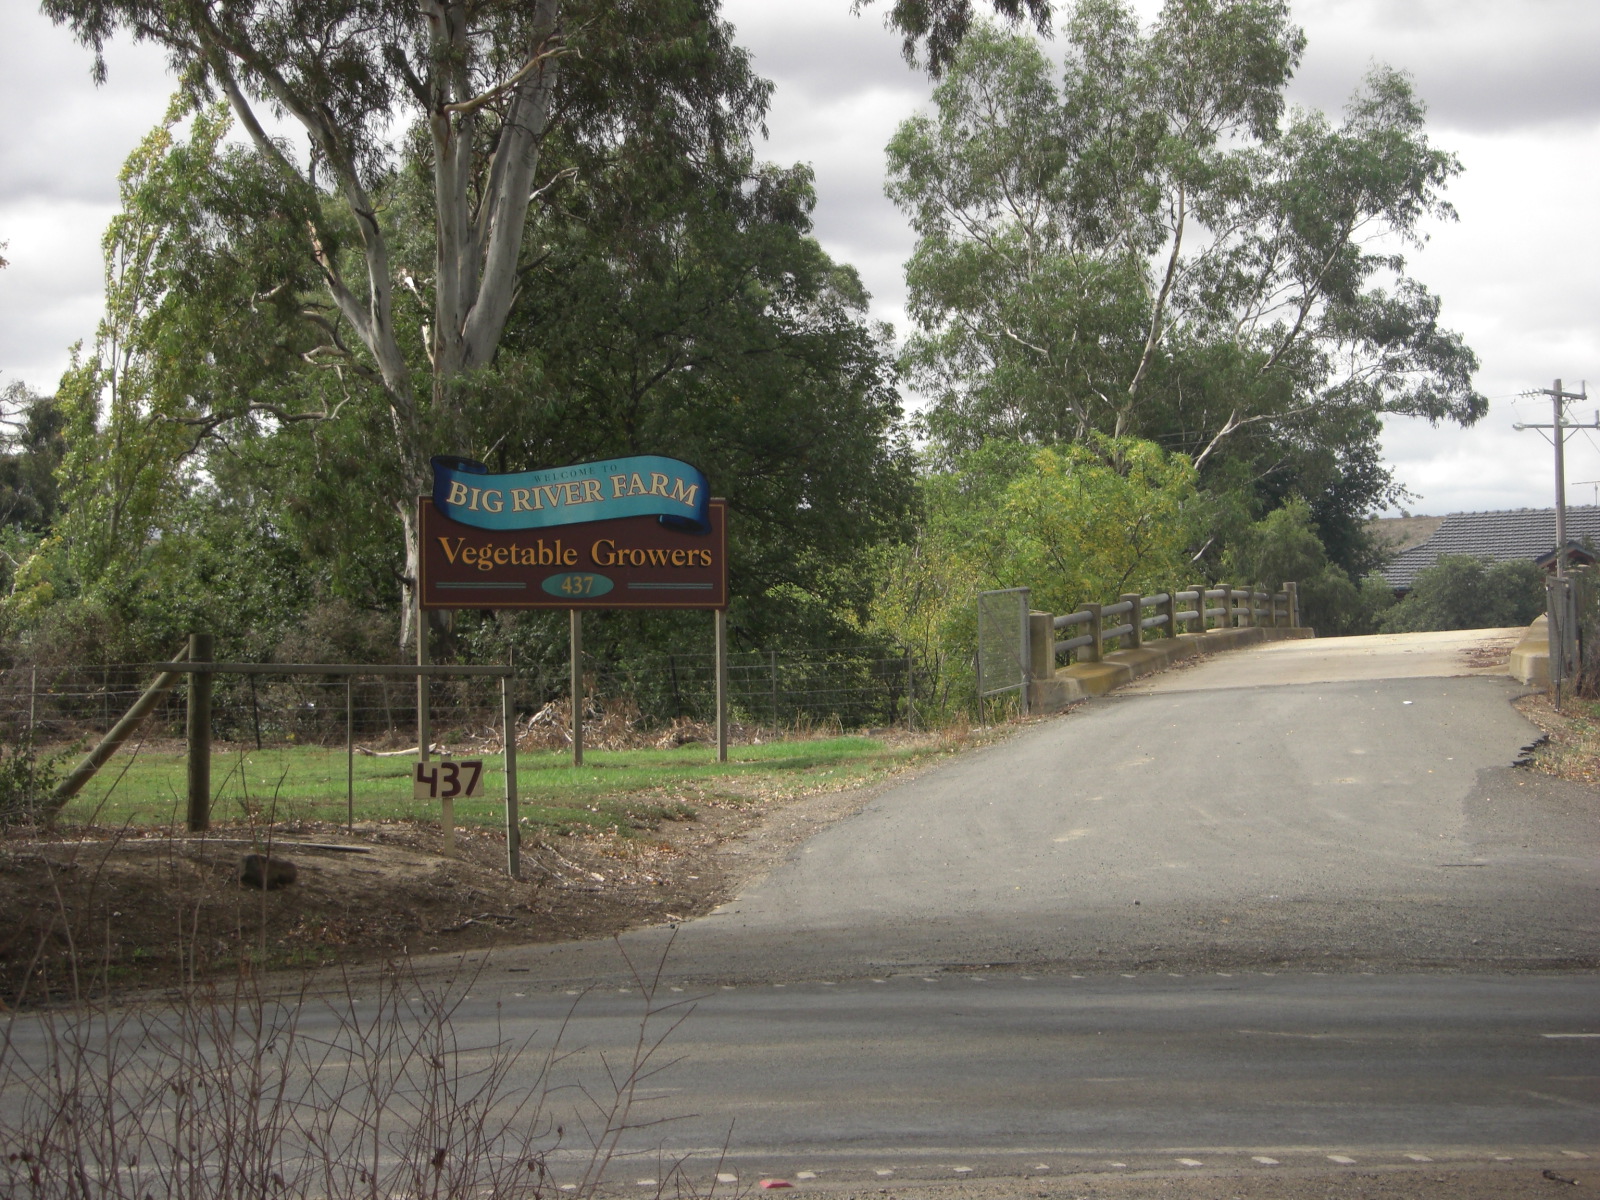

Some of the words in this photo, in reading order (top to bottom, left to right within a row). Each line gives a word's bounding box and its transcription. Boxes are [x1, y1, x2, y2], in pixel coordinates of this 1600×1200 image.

[534, 467, 596, 482] WELCOME
[603, 464, 617, 474] TO
[446, 480, 504, 513] BIG
[510, 478, 604, 512] RIVER
[610, 472, 698, 507] FARM
[438, 537, 578, 571] Vegetable
[591, 539, 712, 566] Growers
[561, 576, 594, 594] 437
[417, 761, 482, 797] 437
